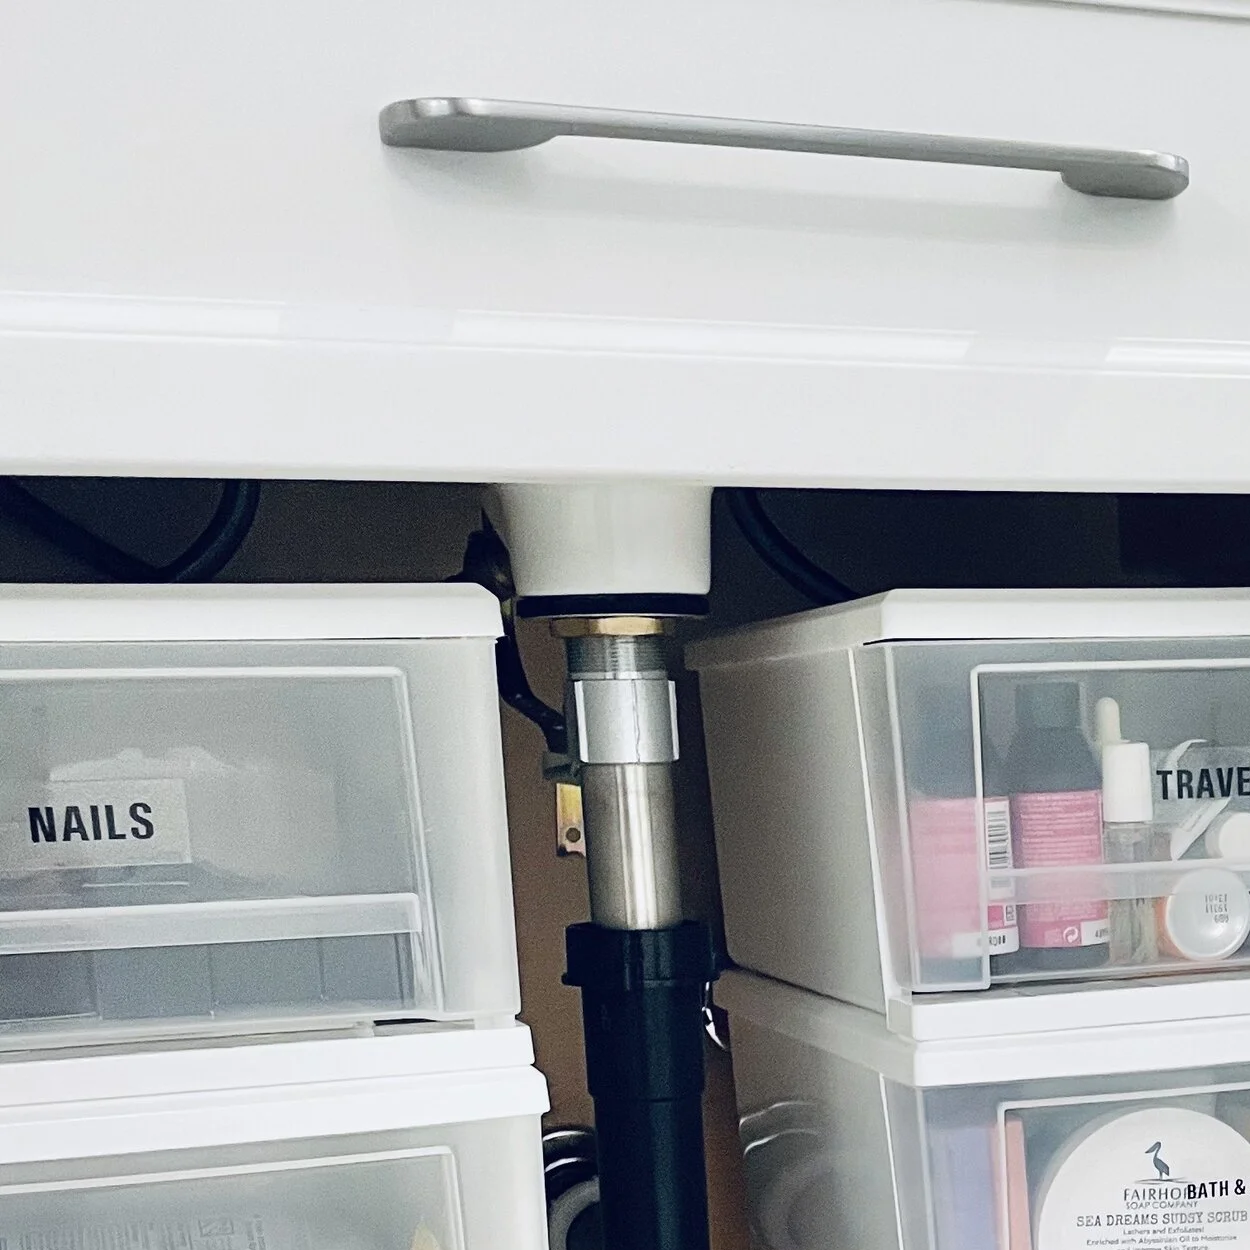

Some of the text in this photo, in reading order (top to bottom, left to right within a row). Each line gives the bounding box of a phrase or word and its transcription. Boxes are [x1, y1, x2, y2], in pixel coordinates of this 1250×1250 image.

[27, 802, 155, 844] NAILS
[1187, 1180, 1229, 1200] BATH
[1234, 1178, 1246, 1195] &
[1126, 1200, 1199, 1210] SOAP COMPANY
[1076, 1210, 1248, 1227] SEA DREAMS SUDSY SCRUB
